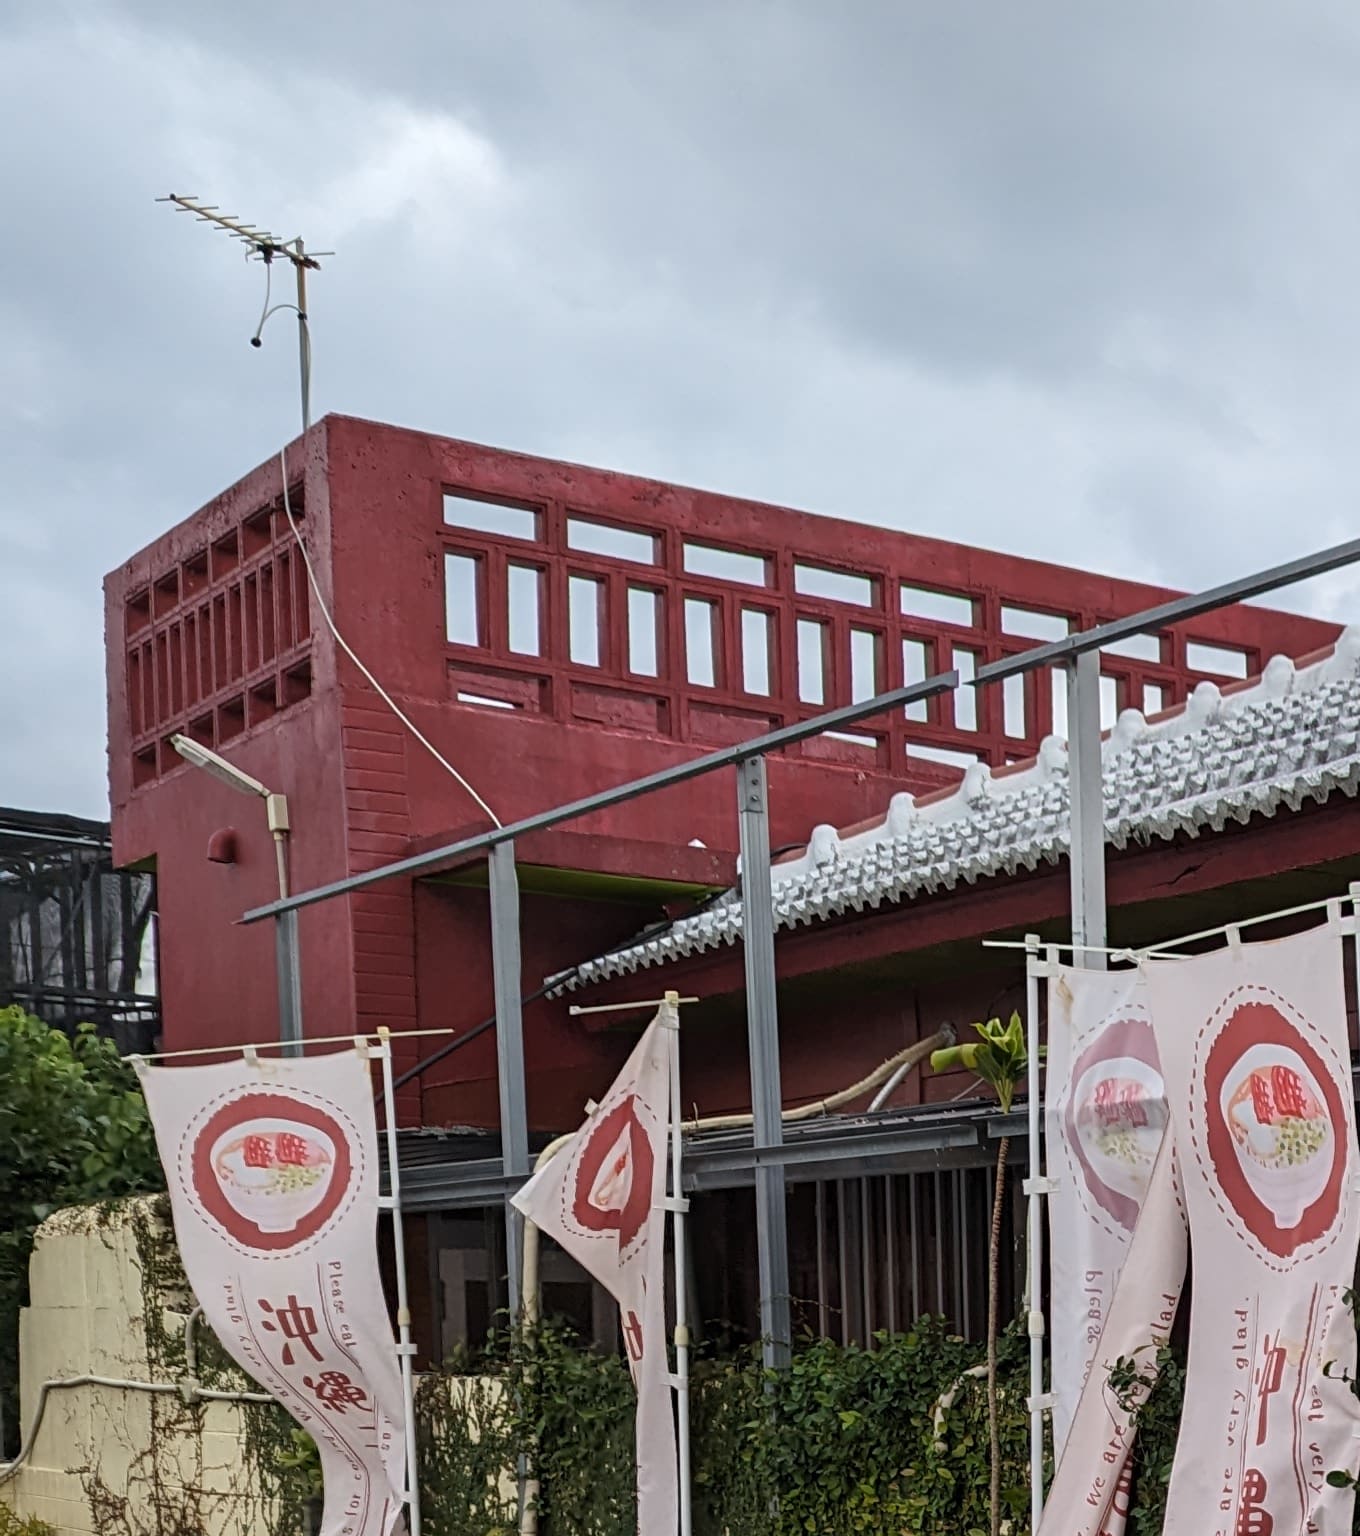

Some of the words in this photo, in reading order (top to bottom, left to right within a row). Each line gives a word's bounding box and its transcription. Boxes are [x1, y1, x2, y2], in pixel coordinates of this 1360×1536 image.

[1232, 1296, 1250, 1371] glad.
[1226, 1388, 1246, 1447] very
[1087, 1476, 1107, 1506] We
[1103, 1425, 1128, 1464] are
[1219, 1466, 1234, 1512] are
[1307, 1442, 1326, 1495] very
